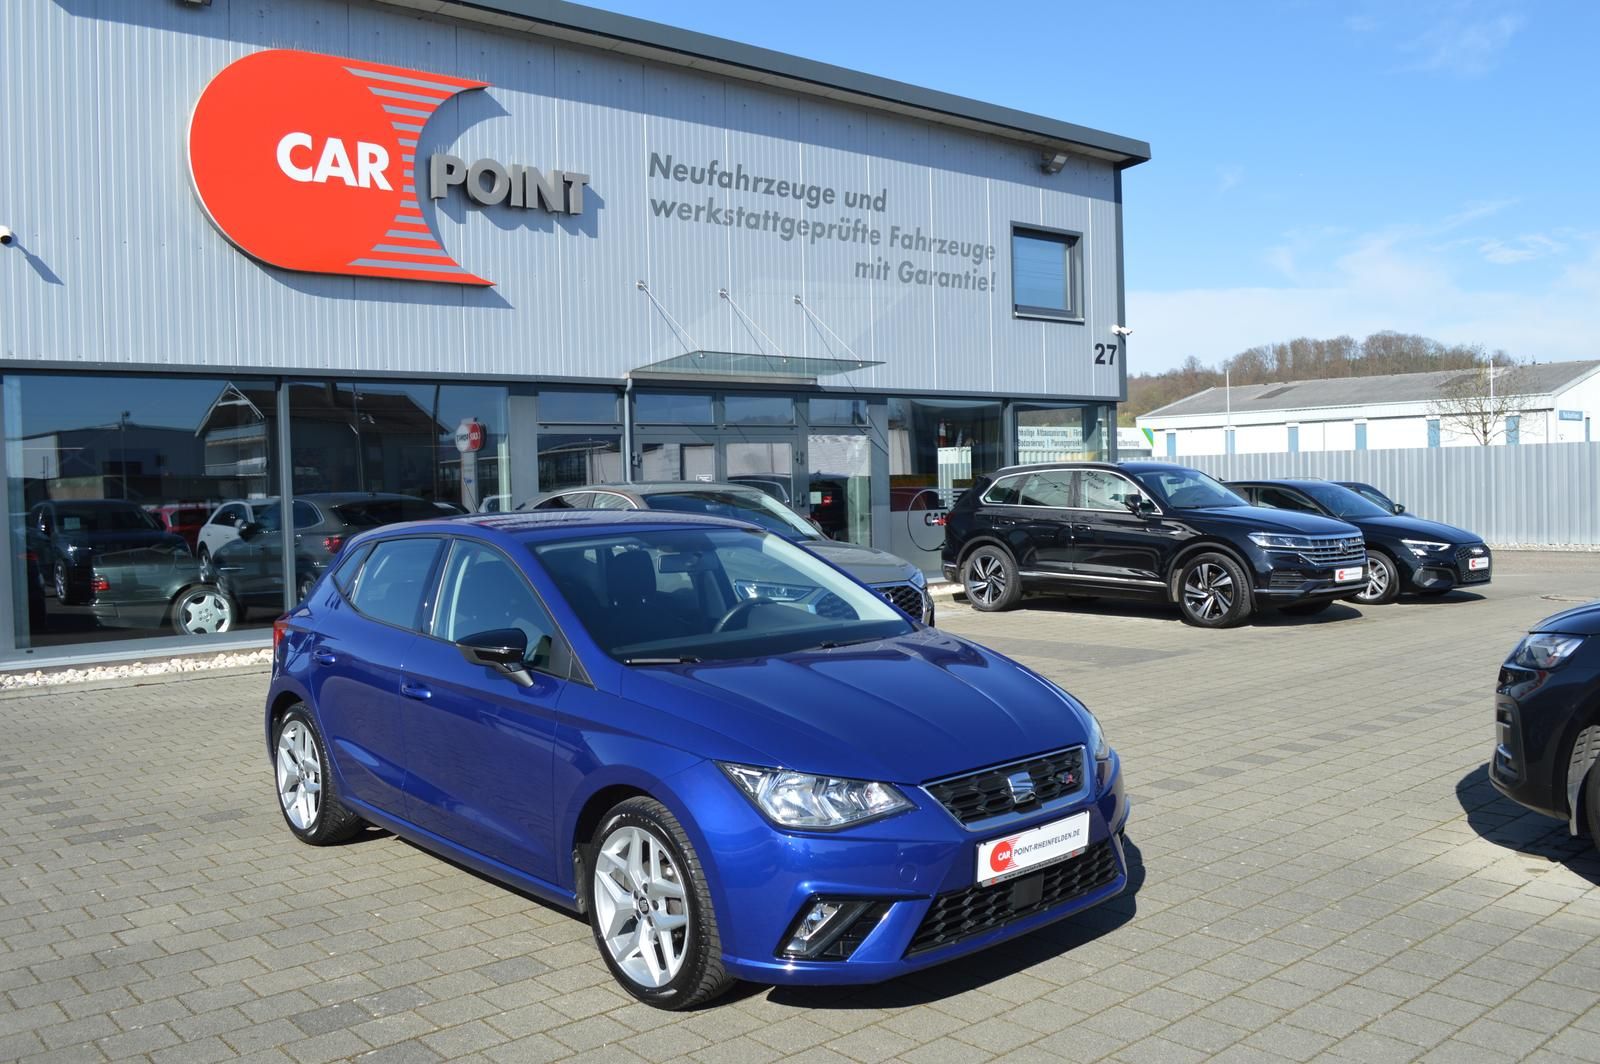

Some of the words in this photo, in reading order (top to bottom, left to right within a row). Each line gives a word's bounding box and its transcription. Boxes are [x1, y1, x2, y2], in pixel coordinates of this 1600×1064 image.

[276, 131, 394, 191] CAR
[430, 152, 590, 215] POINT
[649, 152, 836, 209] Neufahrzeuge
[844, 188, 887, 212] und
[650, 197, 881, 245] werkstattgeprüfte
[889, 225, 996, 266] Fahrzeuge
[854, 256, 891, 281] mit
[897, 260, 996, 293] Garantie!
[1094, 342, 1117, 365] 27
[997, 850, 1011, 861] CAR
[1013, 828, 1081, 857] POINT-RHEINFELDEN.DE
